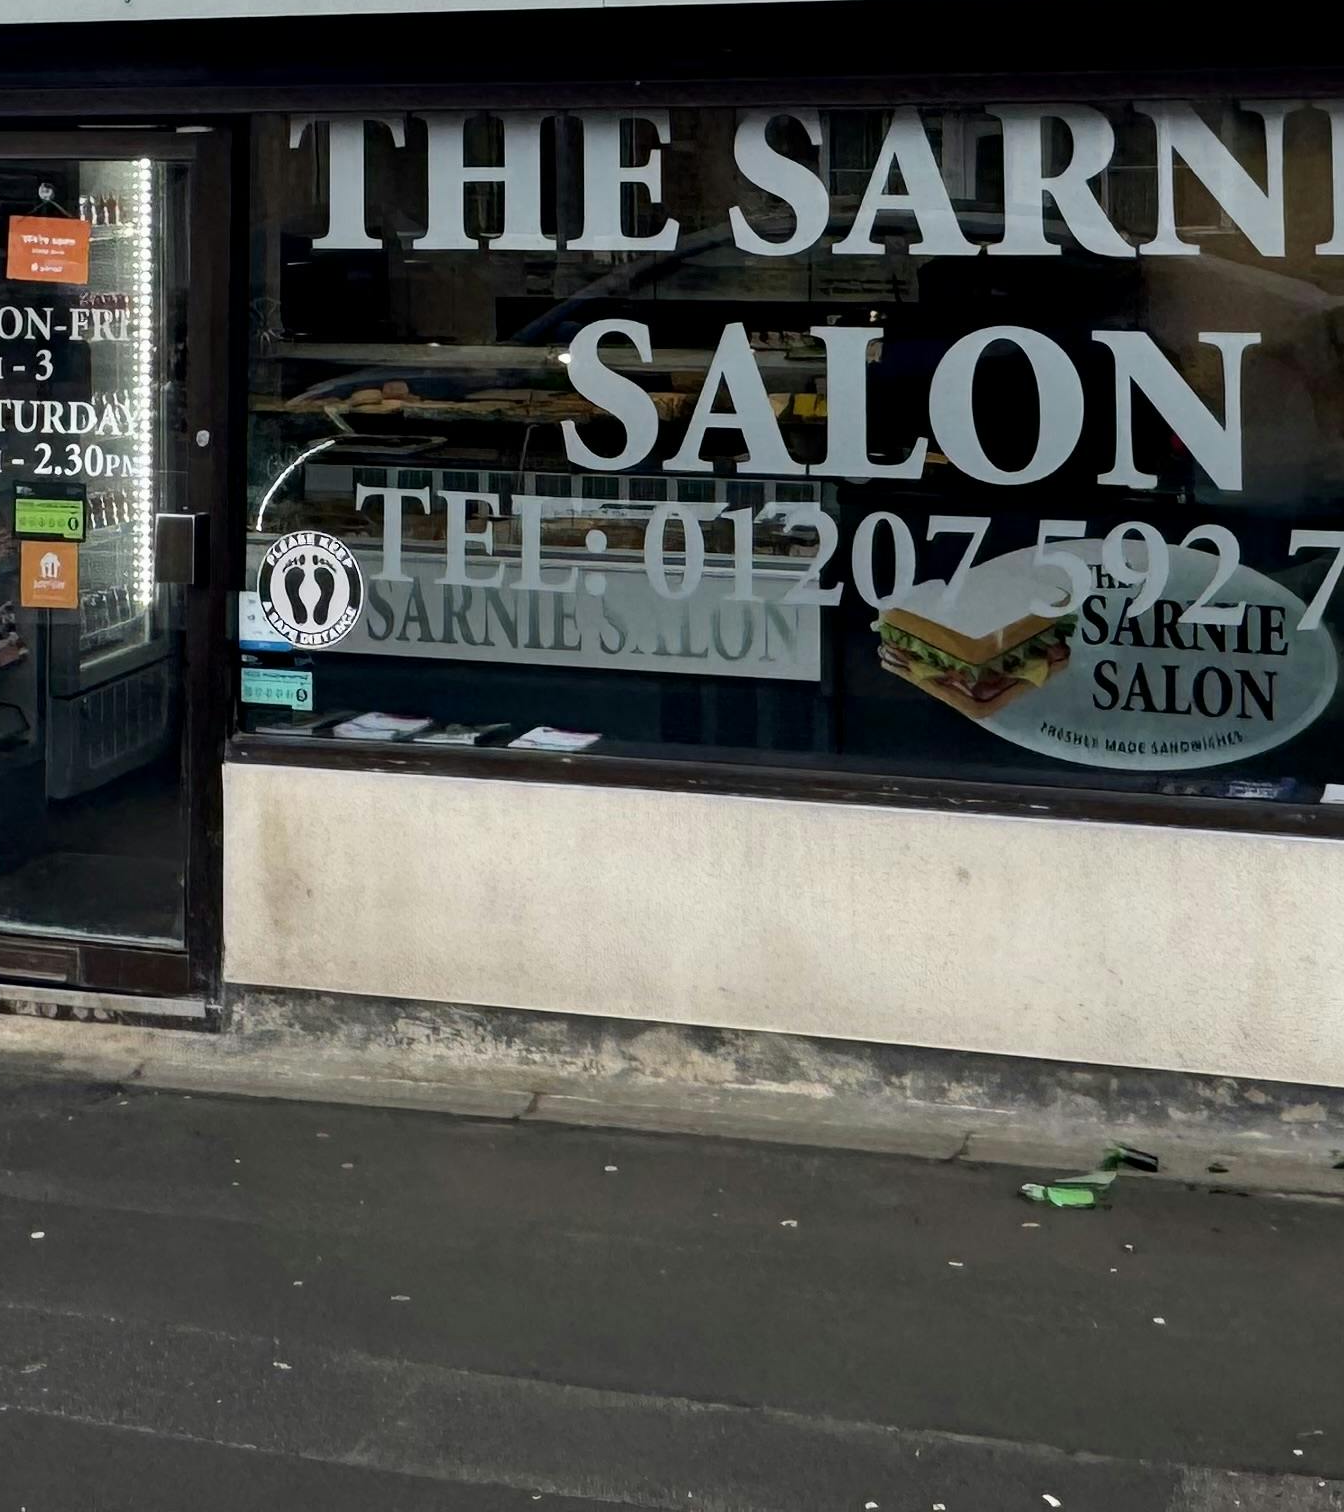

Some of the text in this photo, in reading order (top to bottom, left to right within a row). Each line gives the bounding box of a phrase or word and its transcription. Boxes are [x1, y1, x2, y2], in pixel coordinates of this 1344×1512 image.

[288, 108, 681, 252] THE
[34, 349, 54, 381] 3
[559, 318, 1262, 492] SALON
[355, 483, 608, 597] TEL:
[643, 500, 992, 616] 01207
[1029, 518, 1248, 627] 592
[366, 576, 582, 652] SARNIE
[1080, 594, 1290, 657] SARNIE
[1092, 659, 1278, 722] SALON
[1105, 738, 1147, 755] MADE
